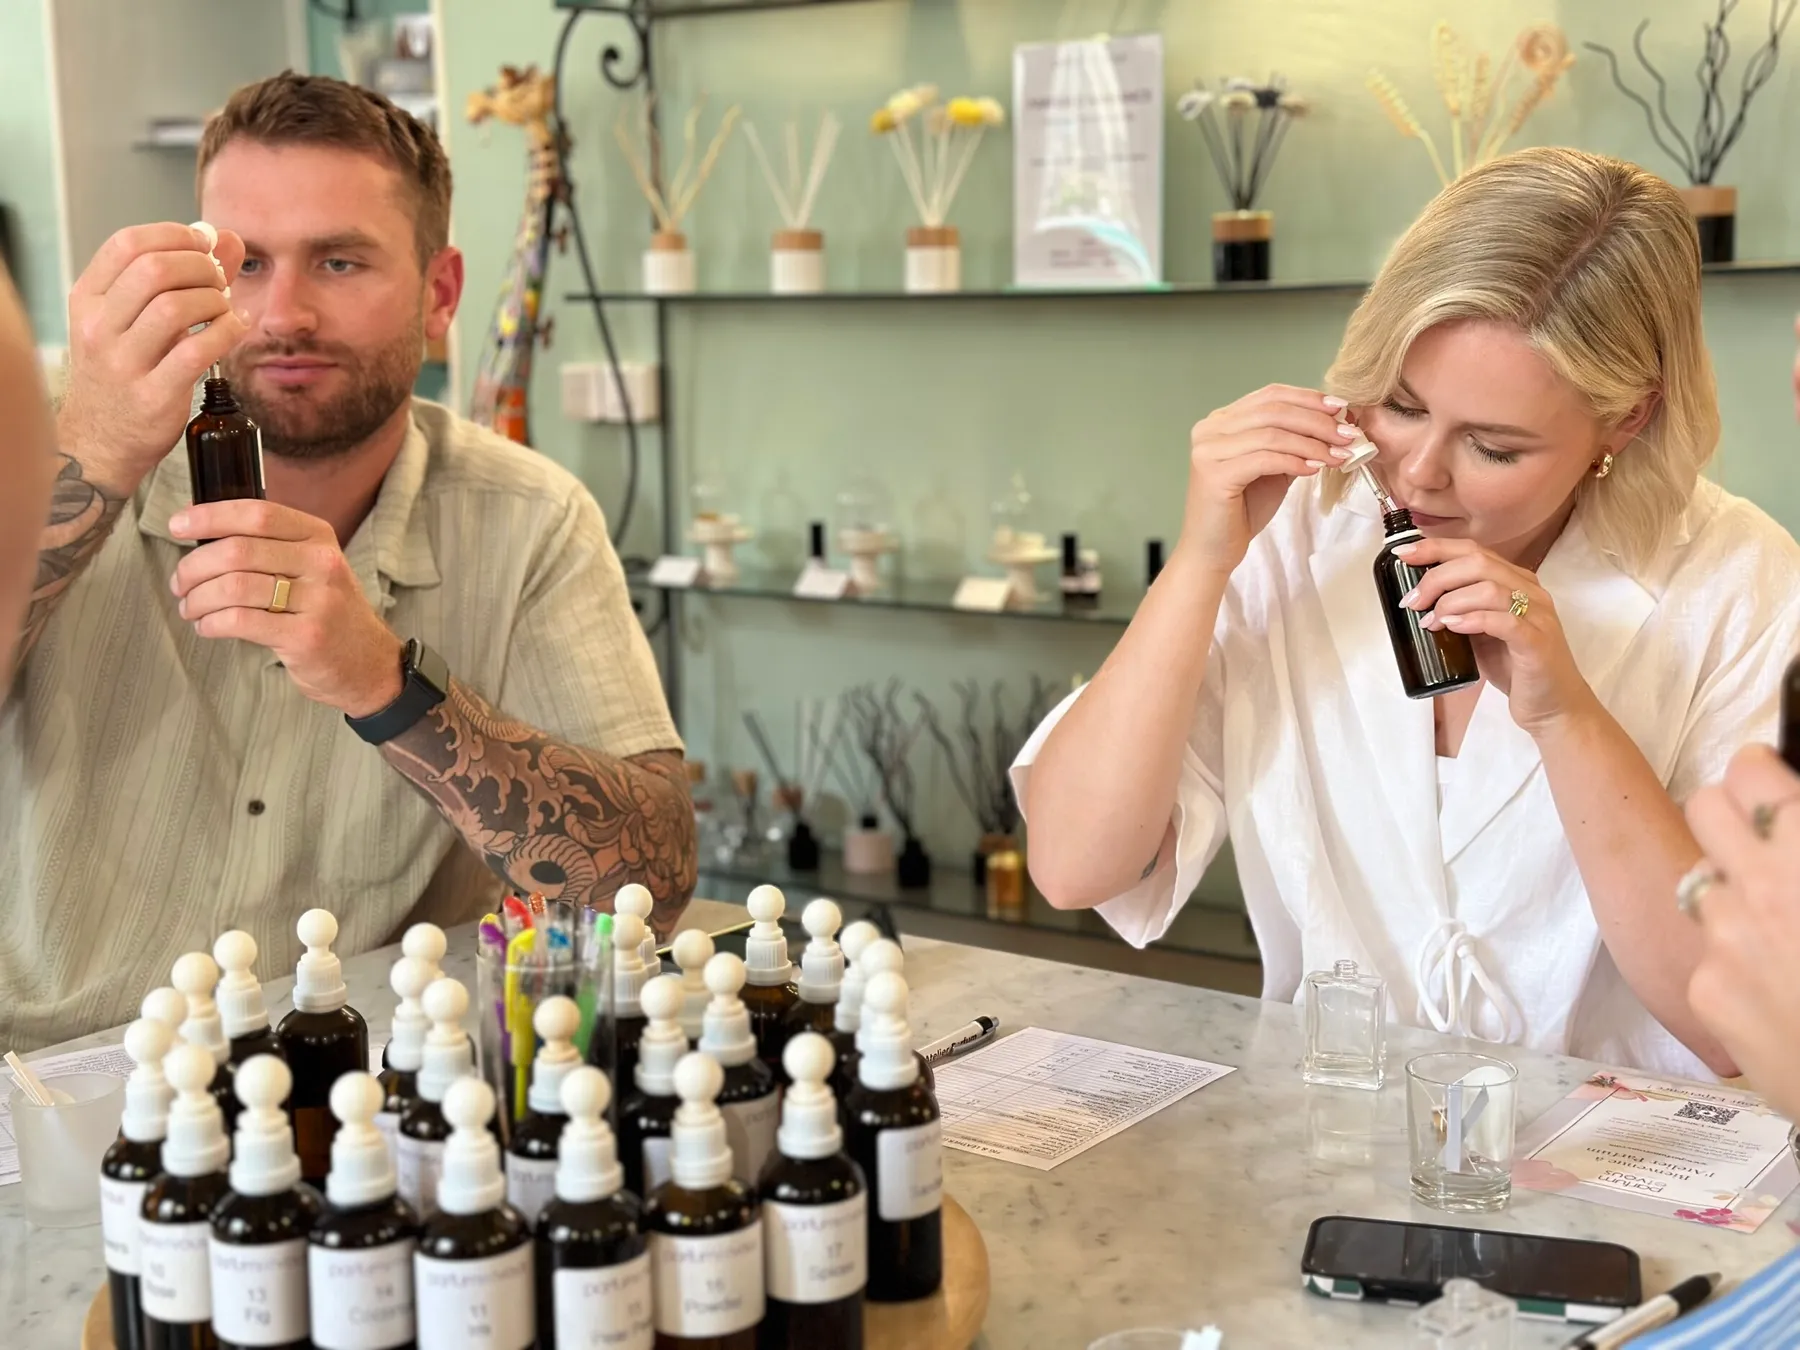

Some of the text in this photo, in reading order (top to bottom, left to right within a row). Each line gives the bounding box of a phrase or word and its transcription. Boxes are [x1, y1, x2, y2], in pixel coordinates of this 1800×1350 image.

[1586, 1146, 1645, 1164] Parfum
[1610, 1158, 1691, 1181] Bienvenue
[1597, 1174, 1664, 1193] parfum
